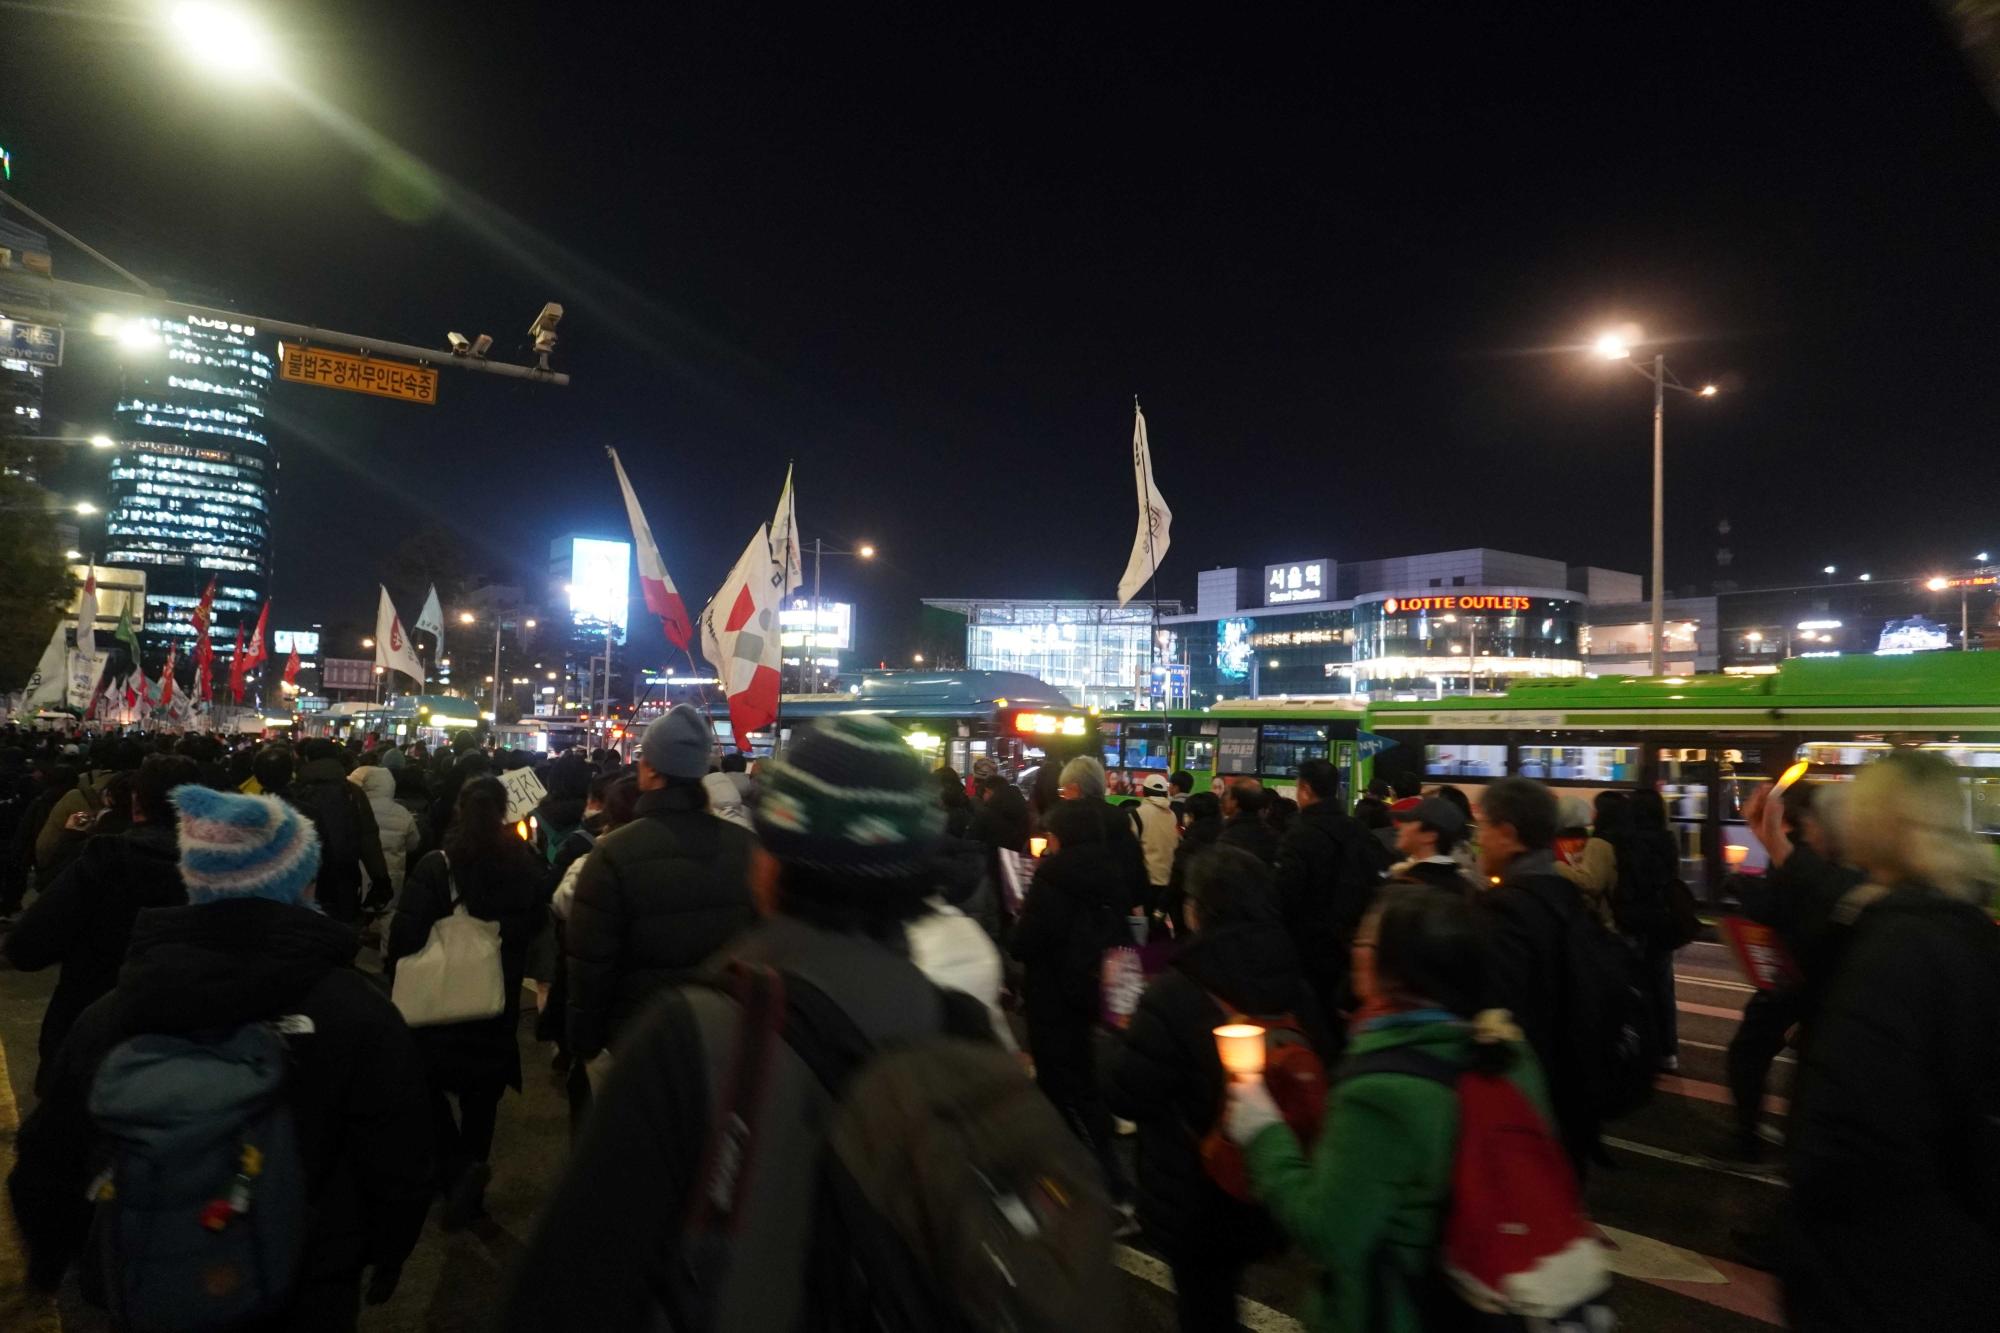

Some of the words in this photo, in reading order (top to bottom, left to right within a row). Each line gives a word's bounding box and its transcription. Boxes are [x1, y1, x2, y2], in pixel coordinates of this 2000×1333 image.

[287, 351, 432, 400] 불법주정차무인단속중
[1269, 564, 1321, 590] 서울역
[1400, 597, 1456, 612] LOTTE
[1458, 596, 1530, 610] OUTLETS
